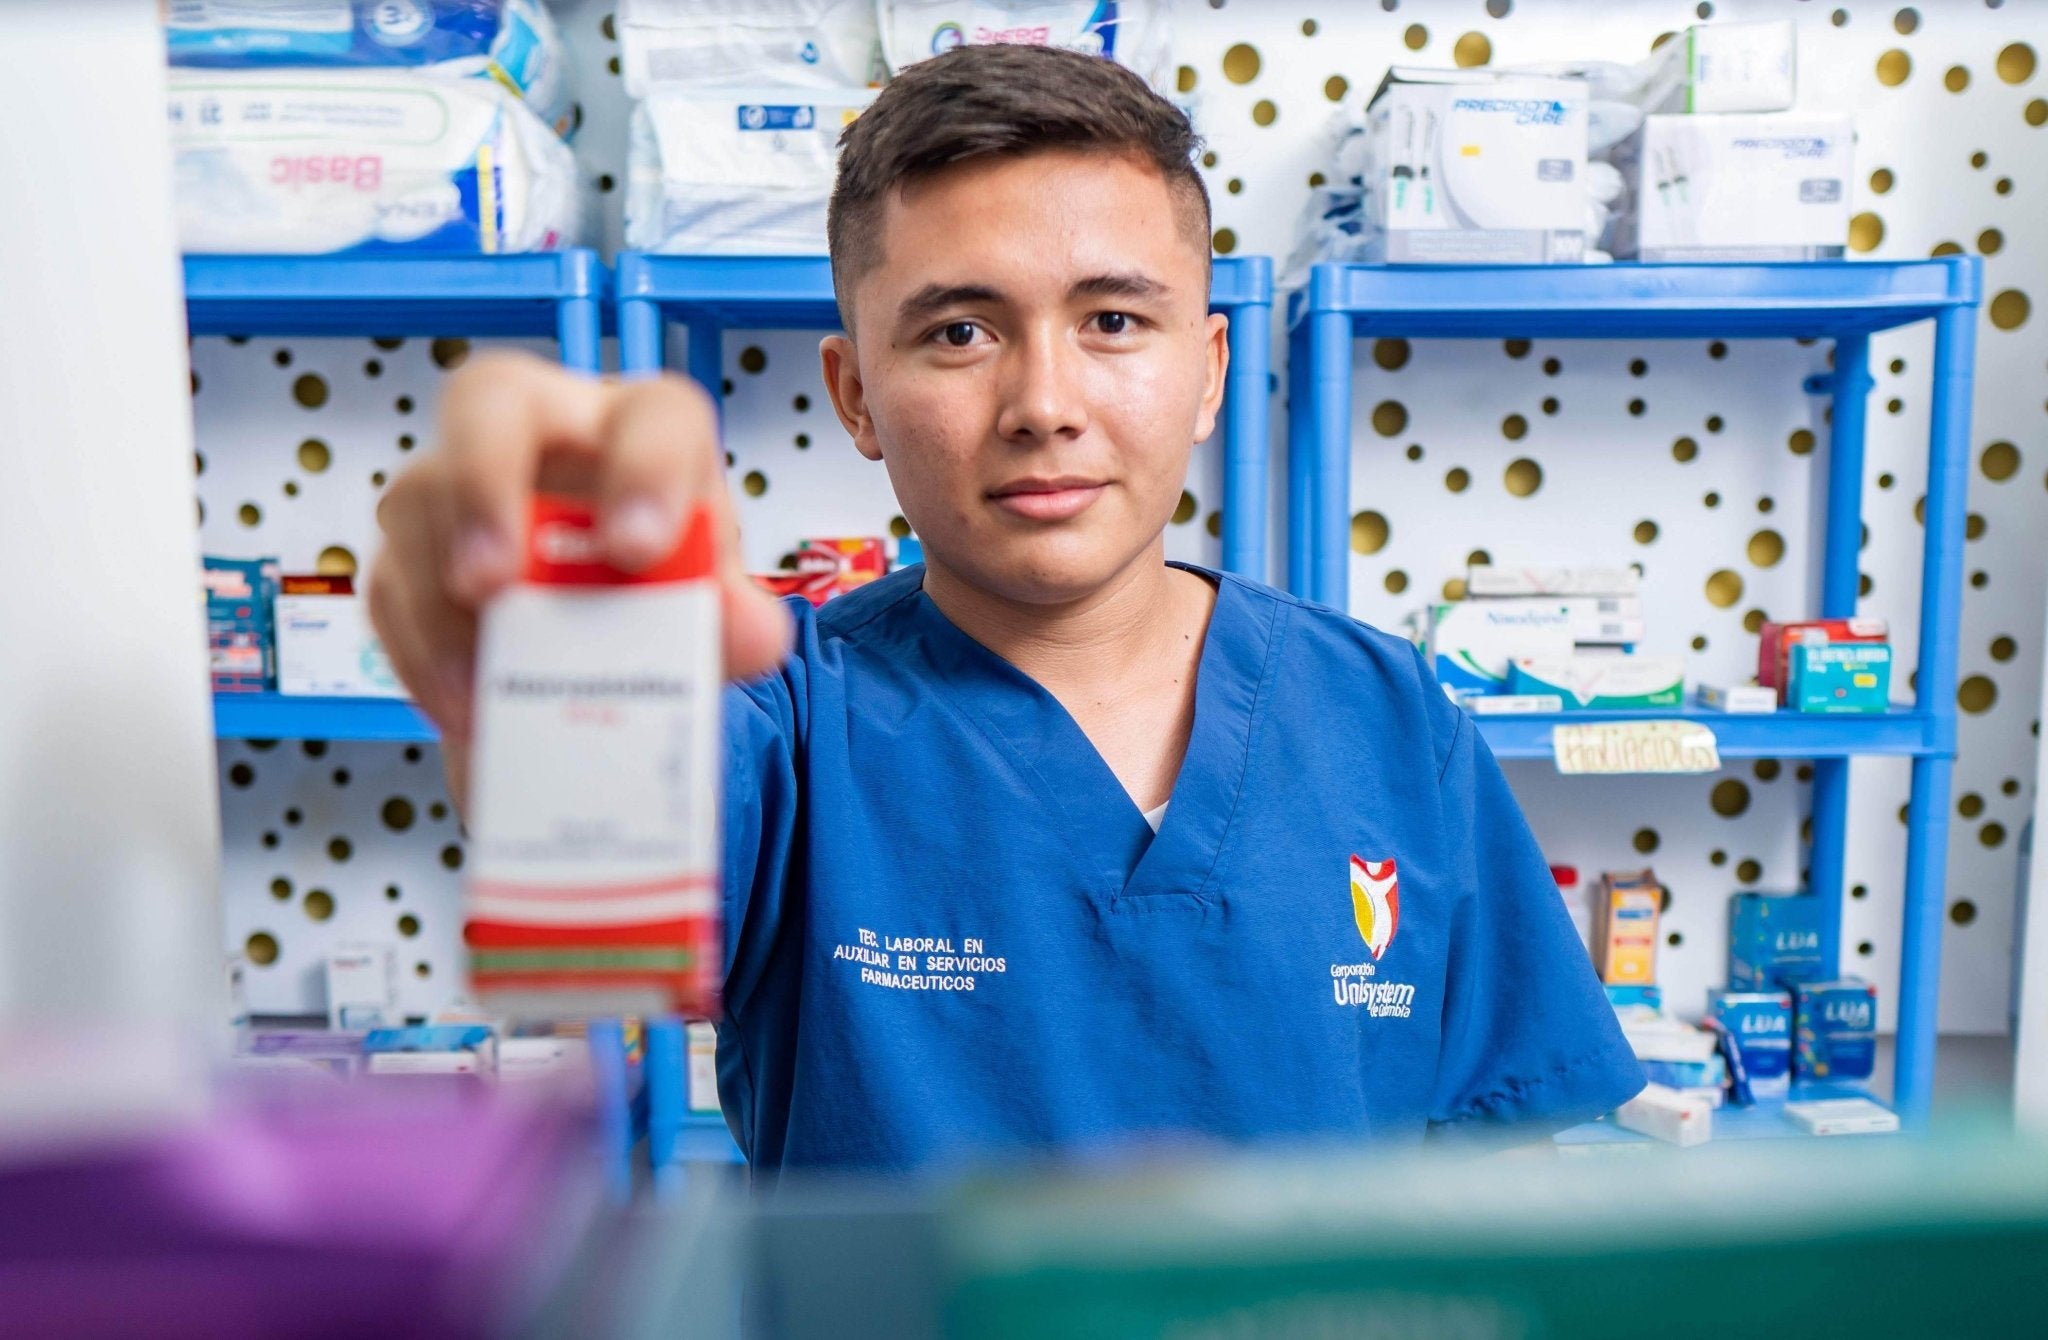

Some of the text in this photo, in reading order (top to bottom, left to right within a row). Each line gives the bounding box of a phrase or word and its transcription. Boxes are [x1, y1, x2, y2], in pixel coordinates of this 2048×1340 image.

[1454, 98, 1556, 113] PRECISION
[1515, 112, 1566, 125] CARE
[270, 155, 383, 190] Basic
[858, 928, 983, 955] TEC. LABORAL EN
[1775, 932, 1818, 950] LUA
[833, 944, 1006, 972] AUXILIAR EN SERVICIOS
[861, 967, 975, 991] FARMACEUTICOS
[1333, 976, 1415, 1011] Unisystem
[1825, 1001, 1870, 1021] LUA
[1741, 1014, 1786, 1033] LUA
